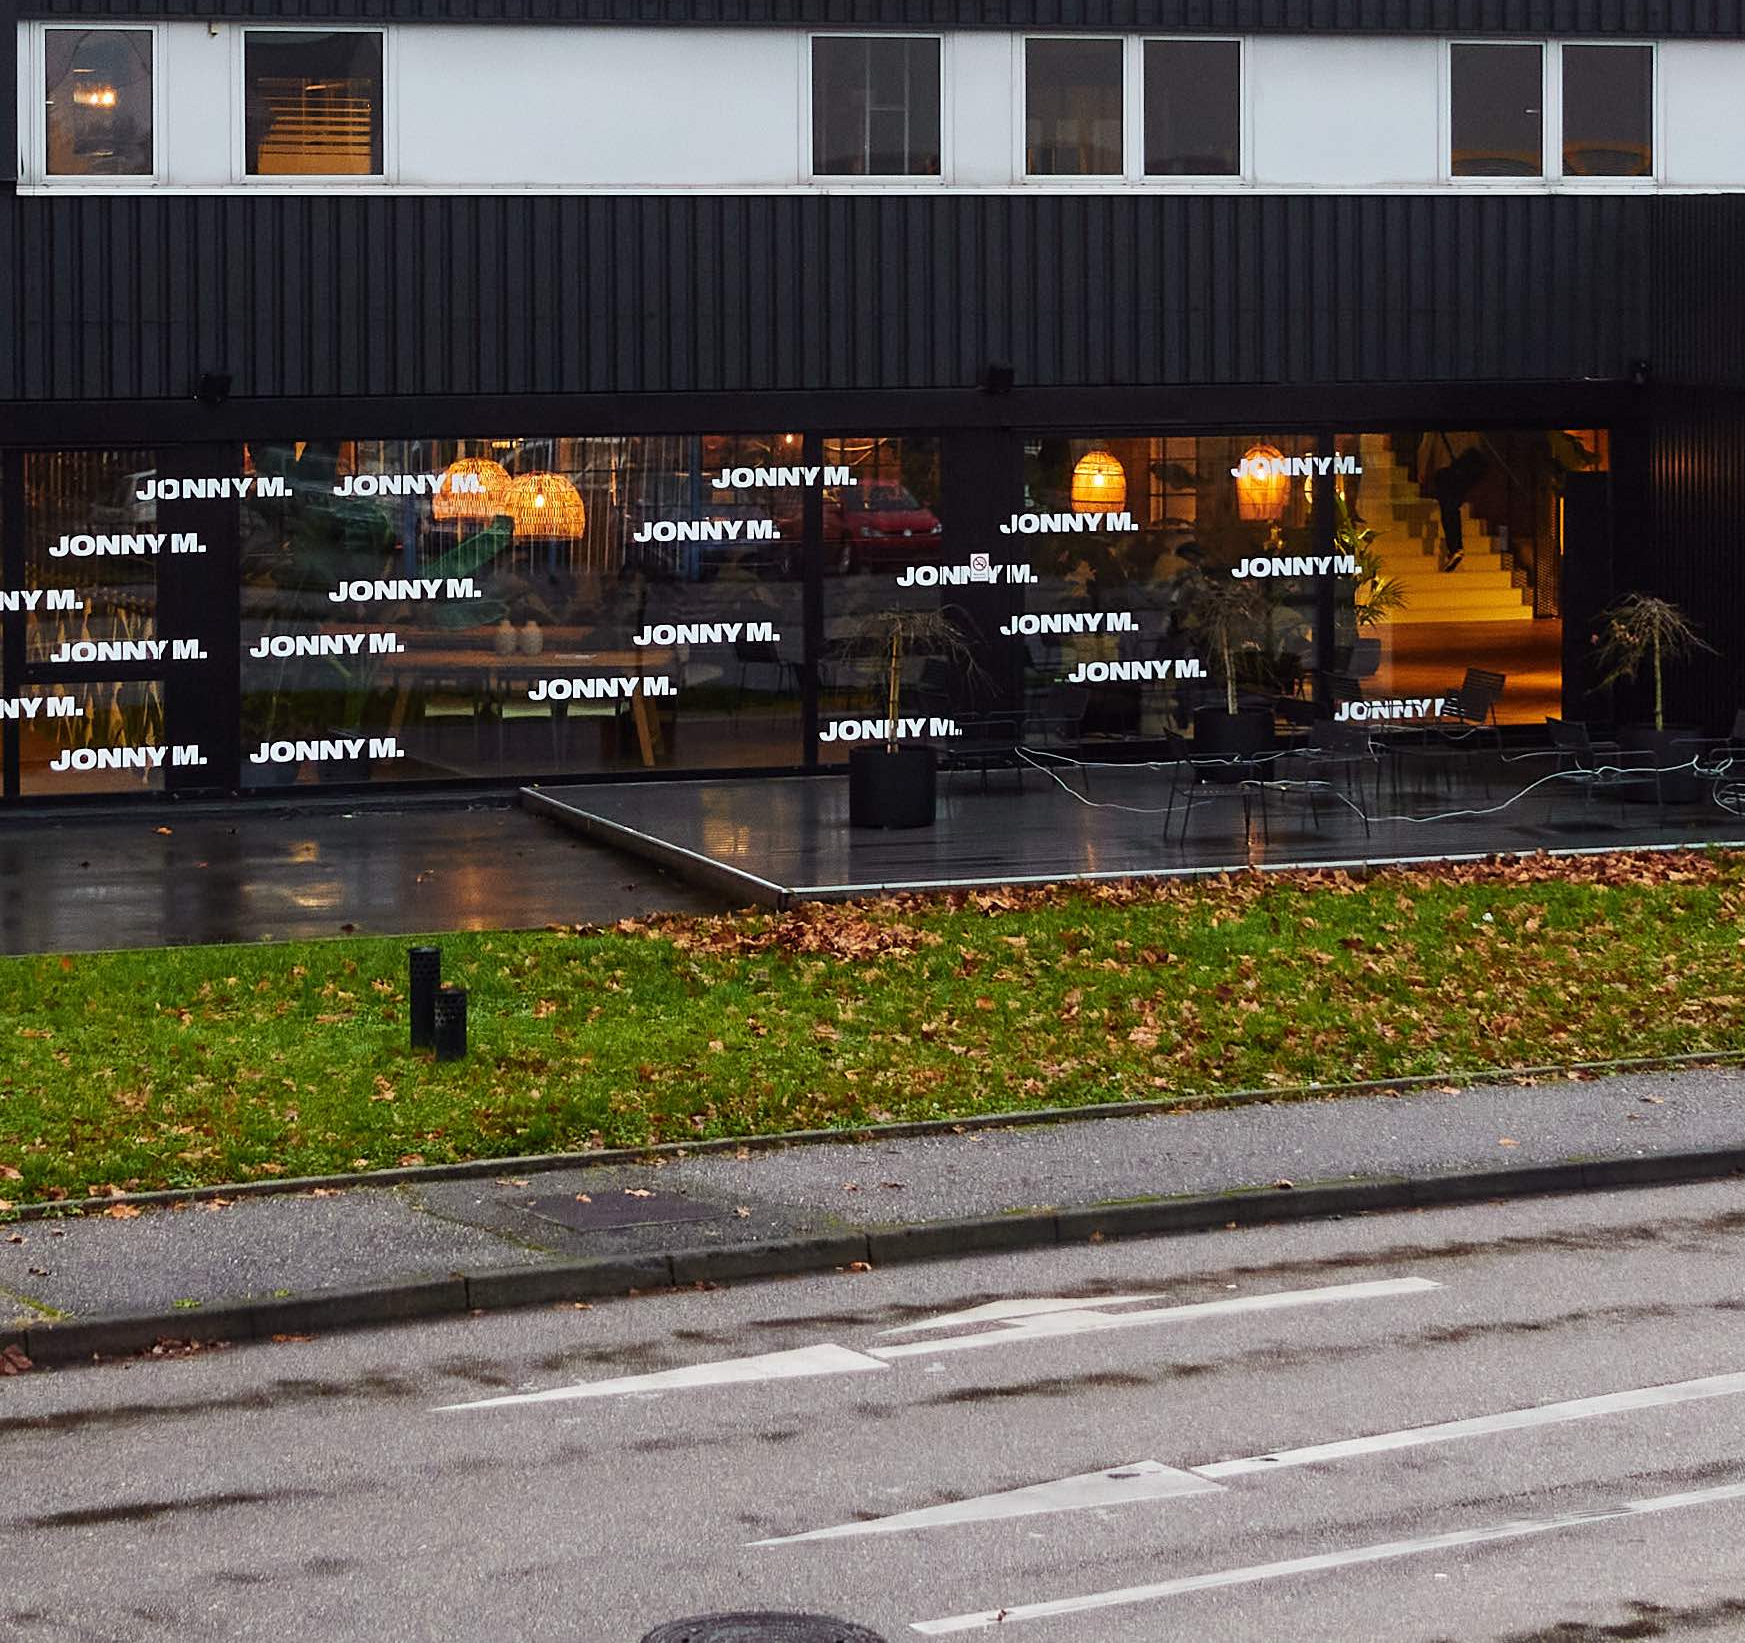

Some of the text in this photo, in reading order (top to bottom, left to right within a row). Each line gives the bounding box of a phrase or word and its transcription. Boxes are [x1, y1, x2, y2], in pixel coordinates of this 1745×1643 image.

[711, 466, 858, 489] JONNY M.
[1230, 456, 1363, 478] JONNY M.
[135, 476, 293, 501] JONNY M.
[333, 473, 487, 496] JONNY M.
[633, 516, 781, 543] JONNY M.
[999, 511, 1139, 534] JONNY M.
[48, 532, 207, 557] JONNY M.
[1006, 564, 1038, 584] M.
[1231, 554, 1363, 578] JONNY M.
[46, 589, 84, 610] M.
[328, 577, 482, 602] JONNY M.
[632, 621, 781, 646] JONNY M.
[999, 611, 1139, 636] JONNY M.
[50, 638, 208, 663] JONNY M.
[249, 632, 405, 658] JONNY M.
[1068, 658, 1207, 683] JONNY M.
[527, 676, 678, 701] JONNY M.
[46, 696, 84, 718] M.
[1334, 699, 1432, 722] JONNY
[819, 717, 963, 742] JONNY M.
[50, 744, 208, 771] JONNY M.
[249, 737, 405, 764] JONNY M.
